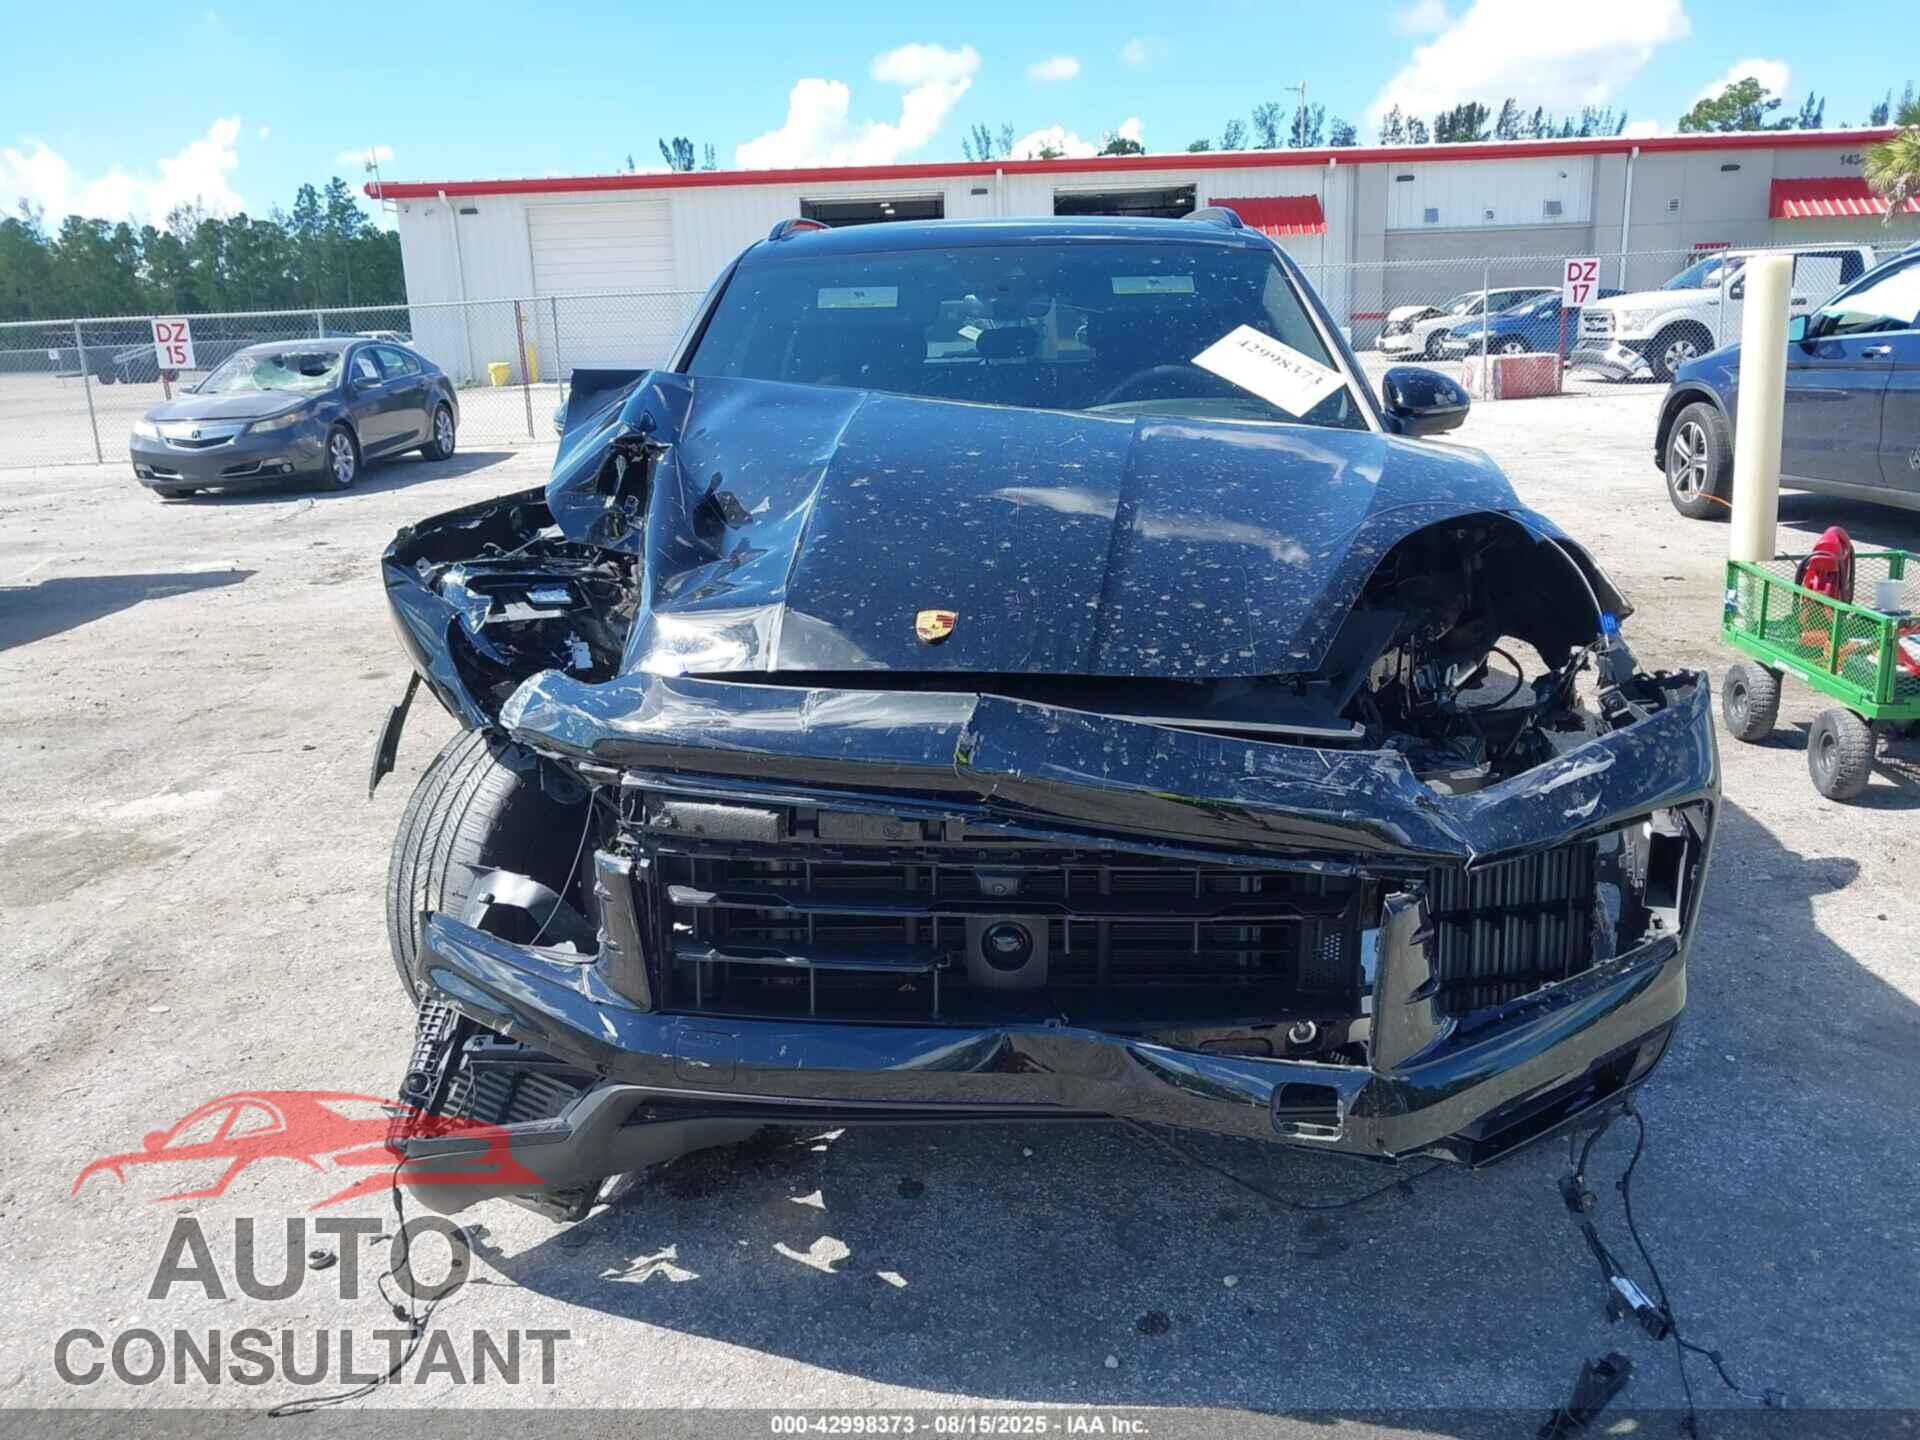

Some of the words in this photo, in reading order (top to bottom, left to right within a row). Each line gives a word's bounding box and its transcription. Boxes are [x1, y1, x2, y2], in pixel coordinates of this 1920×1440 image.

[1567, 262, 1597, 281] DZ
[1572, 284, 1590, 303] 17
[155, 323, 188, 342] DZ
[165, 345, 186, 364] 15
[1236, 339, 1324, 385] 42998373
